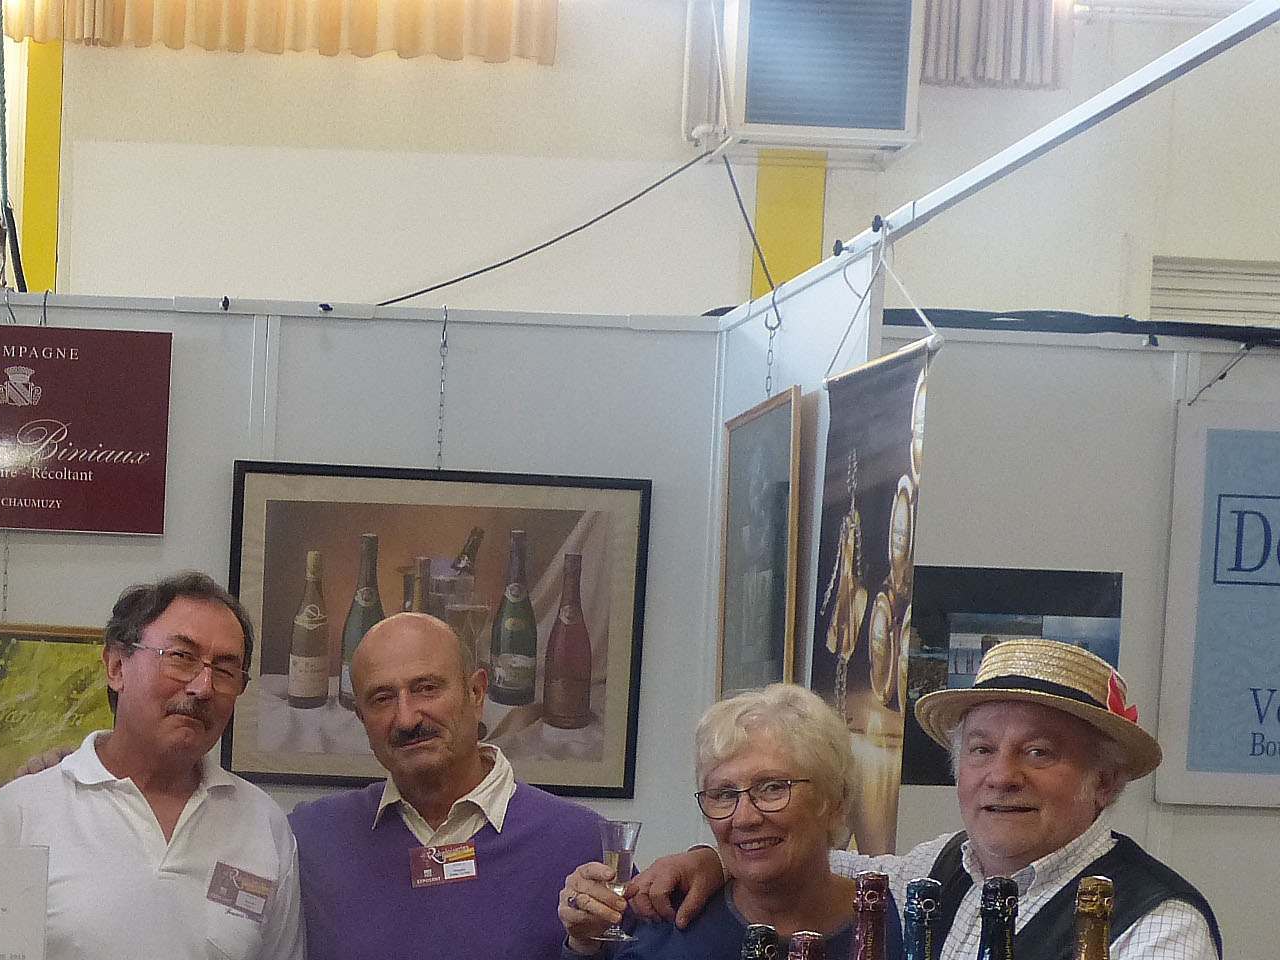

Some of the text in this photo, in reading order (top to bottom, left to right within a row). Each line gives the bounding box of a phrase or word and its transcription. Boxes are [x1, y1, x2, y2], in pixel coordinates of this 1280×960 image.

[16, 418, 151, 466] Biniaux
[31, 466, 94, 482] Récoltant
[1, 497, 63, 509] CHAUMUZY
[1226, 509, 1280, 573] D
